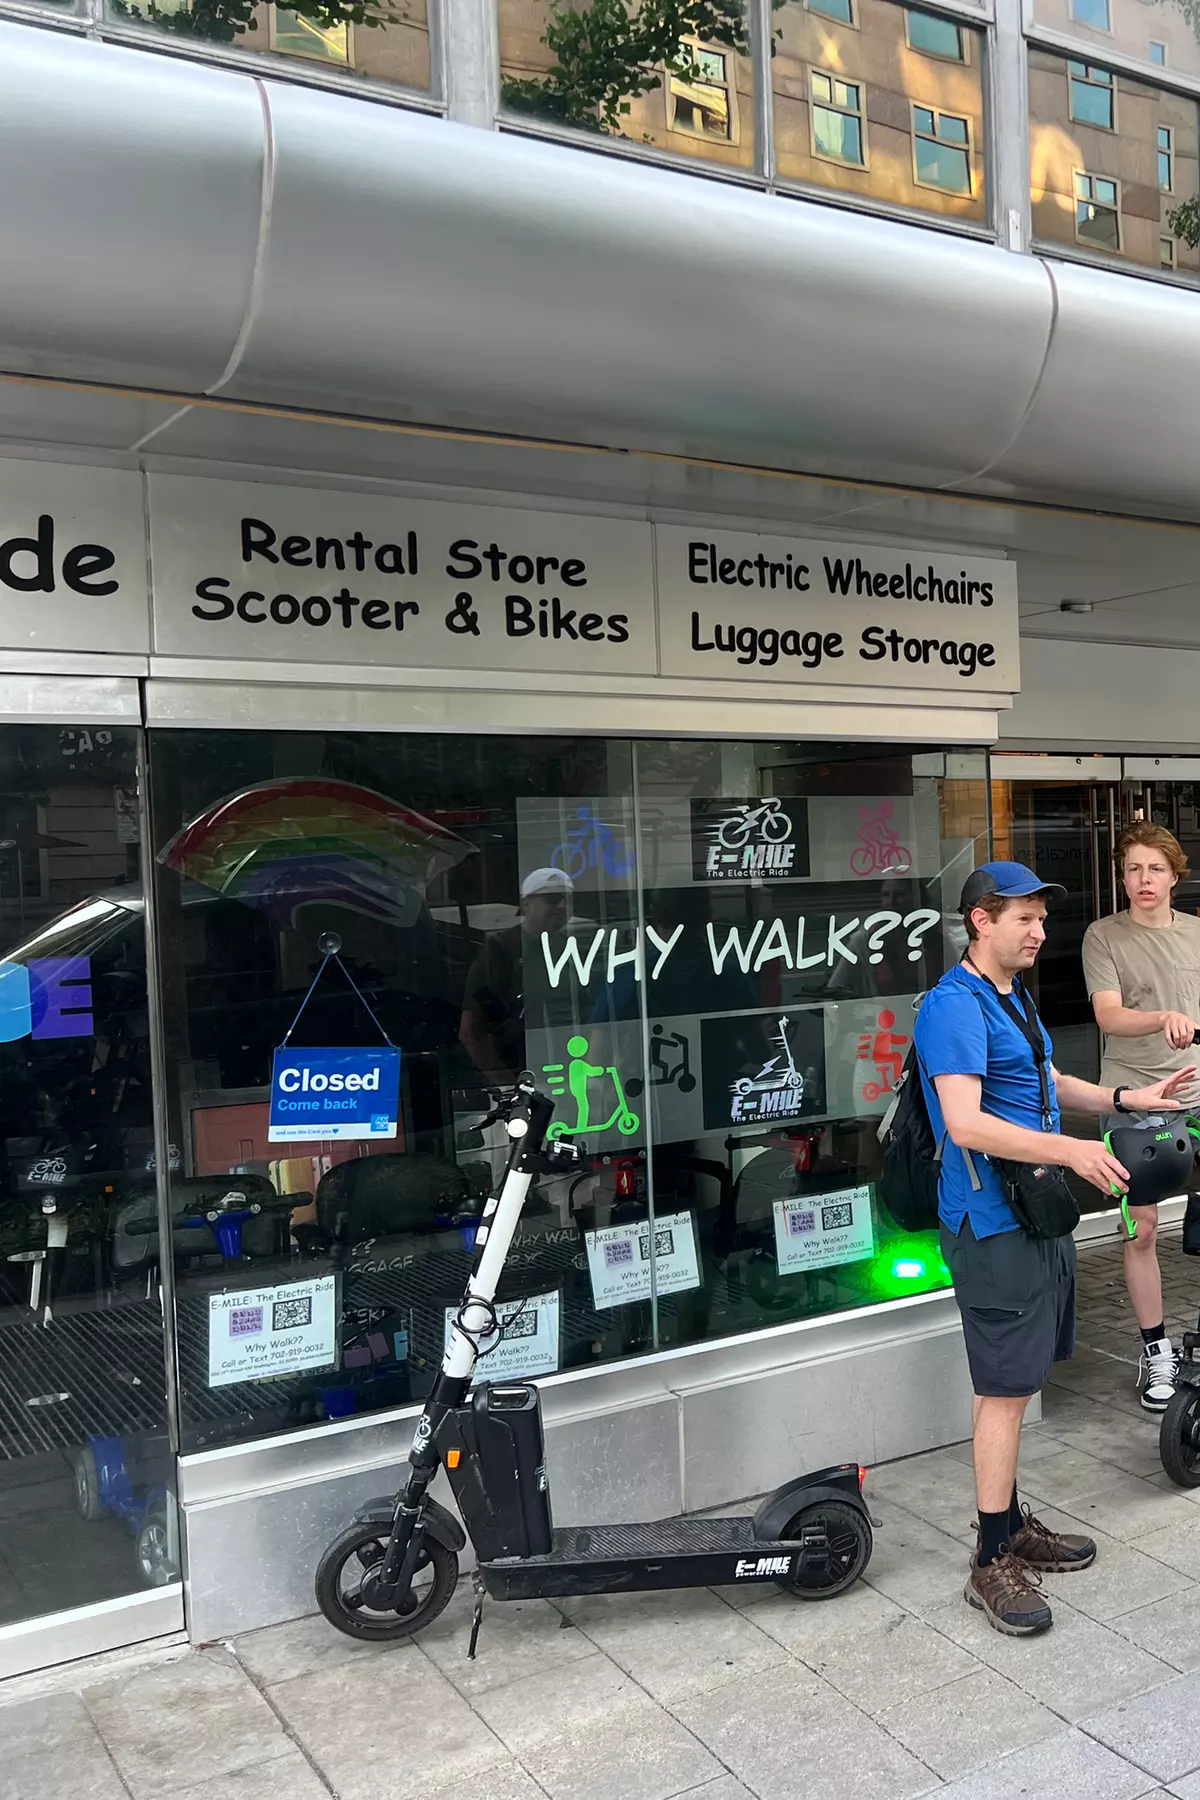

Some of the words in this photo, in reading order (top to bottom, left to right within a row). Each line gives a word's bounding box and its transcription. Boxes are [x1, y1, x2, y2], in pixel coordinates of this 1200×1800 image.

[0, 514, 118, 596] de
[240, 517, 419, 576] Rental
[445, 540, 588, 588] Store
[687, 542, 810, 593] Electric
[822, 556, 994, 607] Wheelchairs
[191, 577, 419, 631] Scooter
[444, 591, 481, 637] &
[504, 596, 629, 643] Bikes
[691, 611, 844, 669] Luggage
[858, 626, 996, 677] Storage
[705, 844, 796, 871] E-MILE
[706, 870, 724, 878] The
[727, 868, 766, 877] Electric
[768, 867, 789, 876] Ride
[541, 923, 685, 989] WHY
[706, 908, 941, 976] WALK??
[278, 1067, 381, 1093] Closed
[277, 1098, 320, 1112] Come
[323, 1097, 358, 1111] back
[730, 1087, 804, 1118] E-MILE
[749, 1111, 780, 1121] Electric
[782, 1109, 799, 1117] Ride
[808, 1200, 822, 1208] The
[823, 1195, 851, 1206] Electric
[624, 1229, 639, 1238] The
[641, 1220, 672, 1235] Elctric
[673, 1217, 691, 1226] Ride
[803, 1241, 820, 1249] Why
[807, 1249, 822, 1257] Text
[620, 1271, 639, 1281] Why
[641, 1263, 670, 1276] Wk??
[256, 1293, 274, 1303] The
[276, 1287, 313, 1300] Electric
[315, 1282, 334, 1293] Ride
[603, 1286, 616, 1294] Call
[626, 1281, 641, 1289] Text
[541, 1297, 558, 1306] Rde
[245, 1343, 267, 1354] Why
[270, 1335, 304, 1349] Walk??
[499, 1345, 530, 1357] Walk??
[221, 1359, 236, 1369] Call
[238, 1358, 247, 1366] or
[249, 1355, 268, 1364] Text
[270, 1343, 324, 1360] 702-919-0032
[480, 1362, 498, 1370] Text
[499, 1352, 549, 1367] 702-919-0032
[735, 1556, 792, 1574] E-MILE
